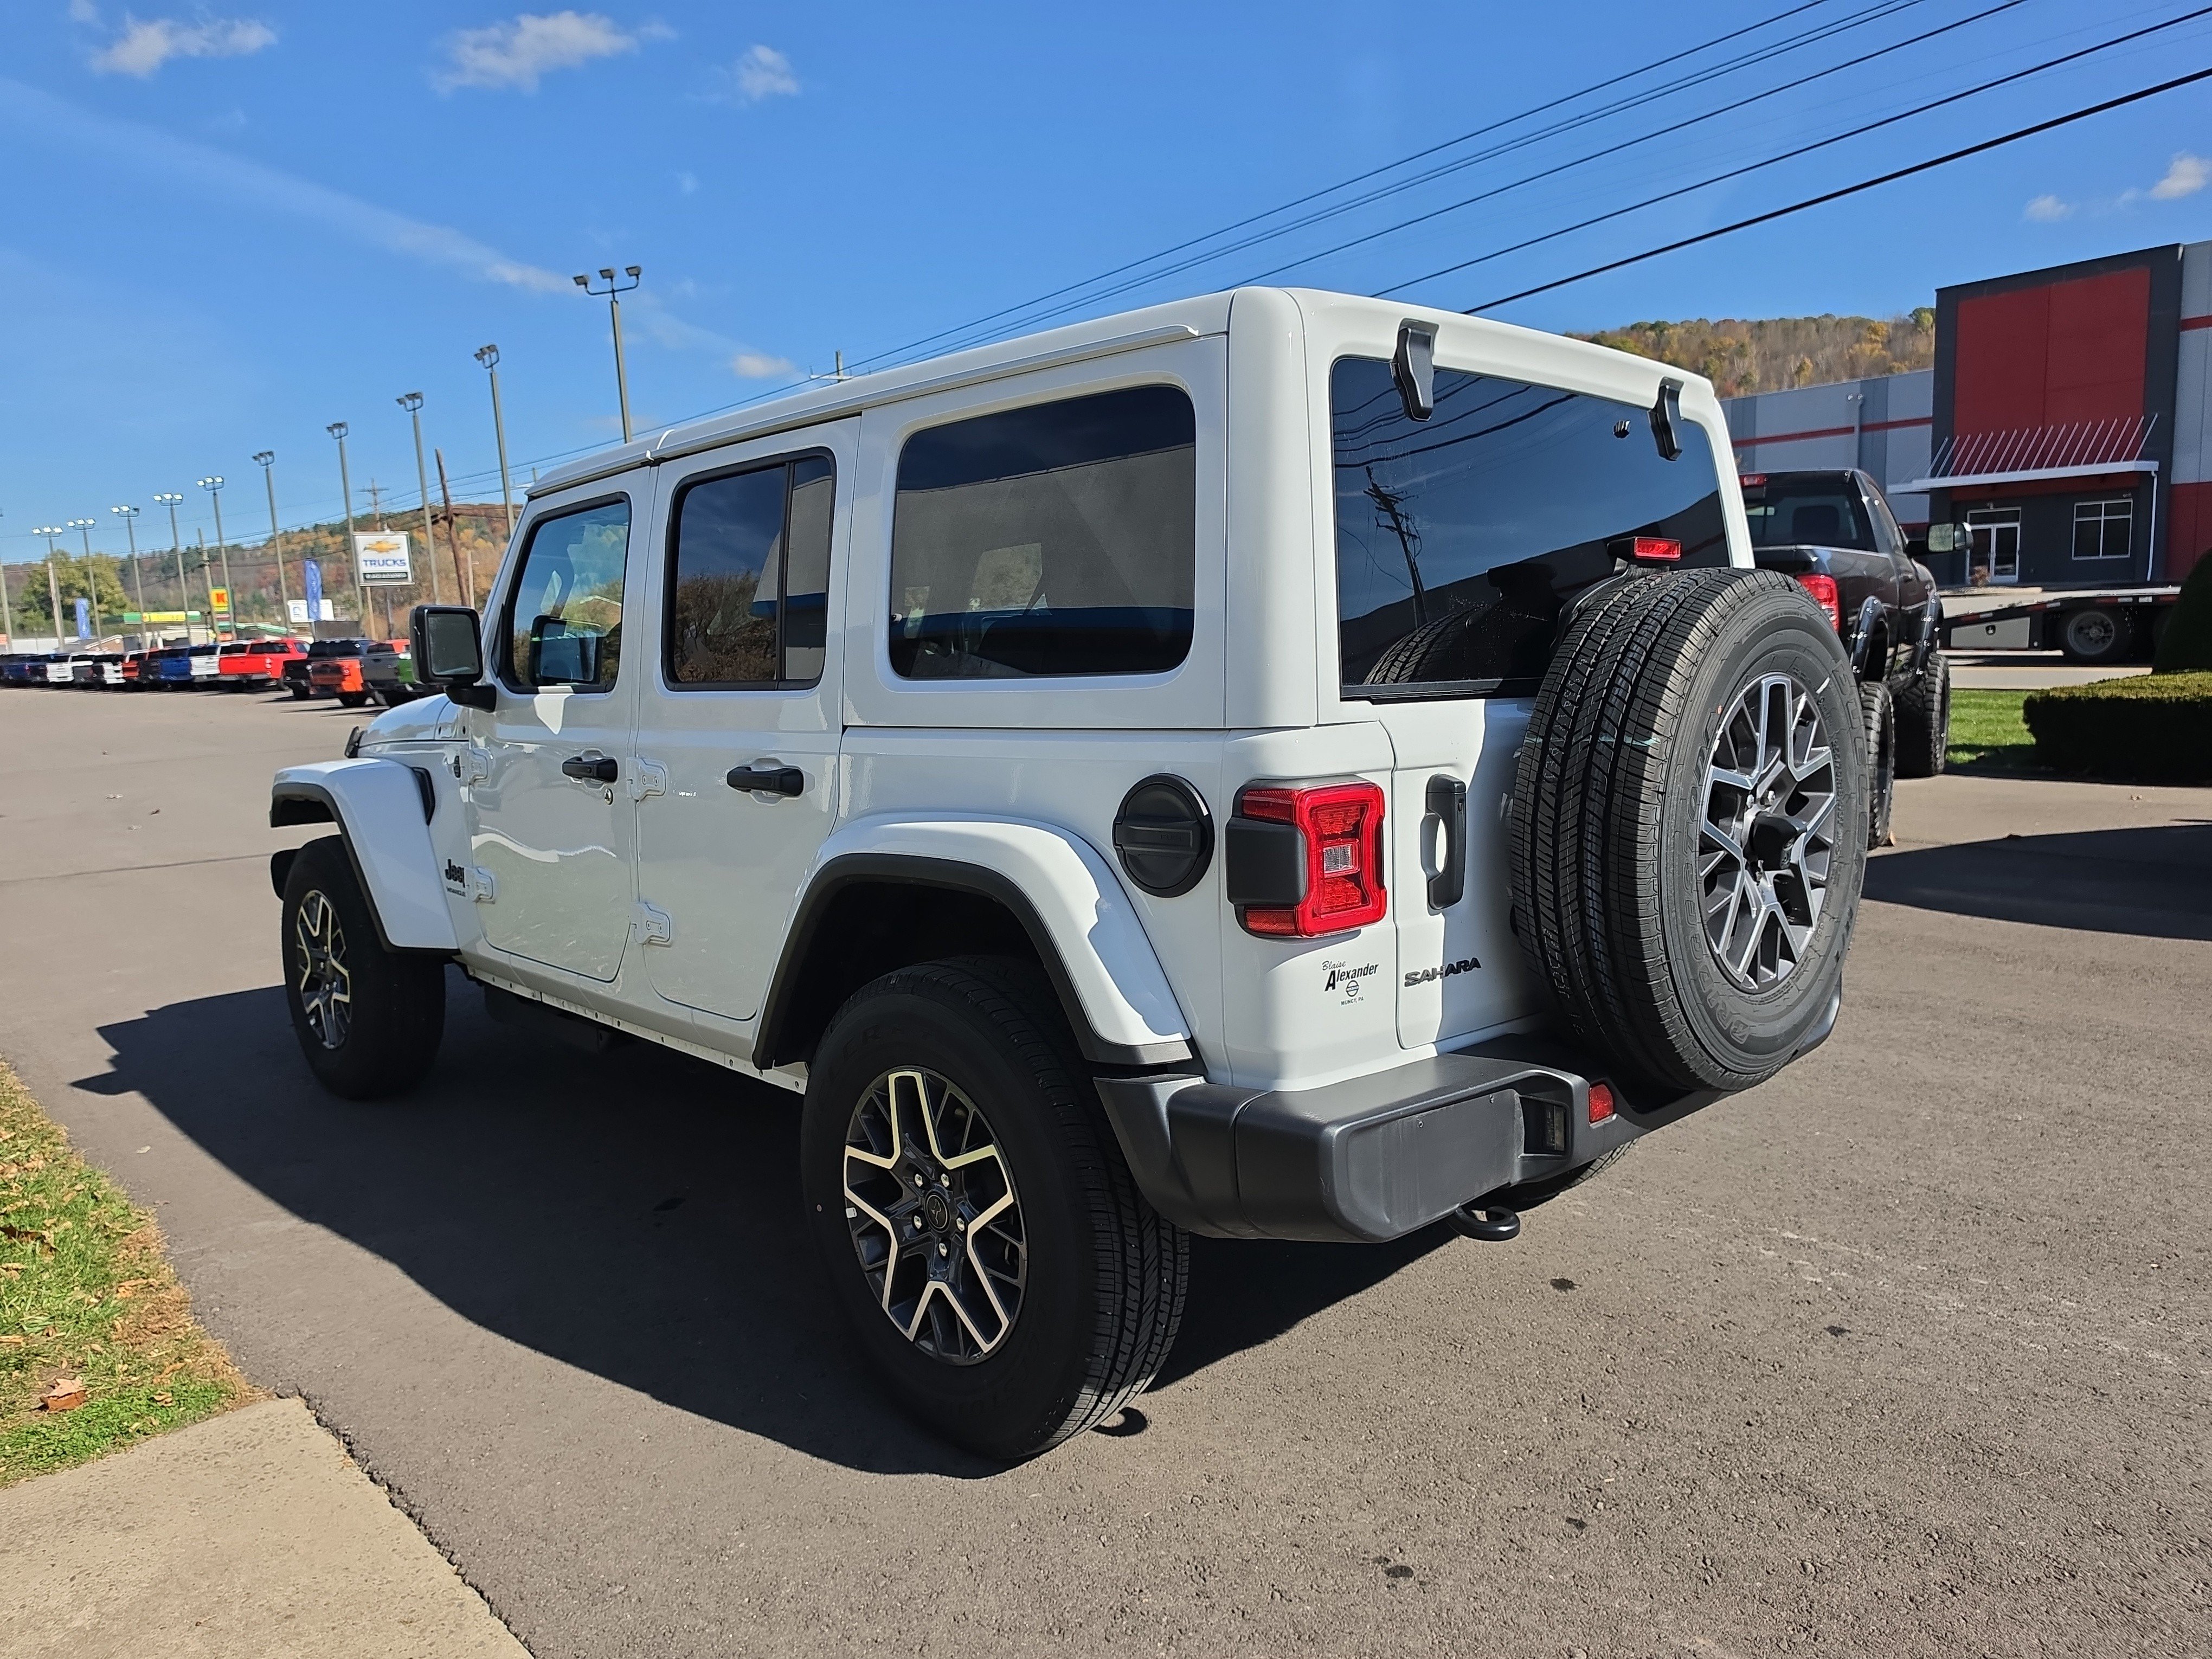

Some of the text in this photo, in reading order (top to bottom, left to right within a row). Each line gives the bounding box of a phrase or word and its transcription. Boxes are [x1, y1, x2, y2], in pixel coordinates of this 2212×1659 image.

[445, 859, 466, 888] Jeep
[1322, 960, 1346, 970] Blaise
[1324, 963, 1379, 992] Alexander
[1404, 957, 1482, 987] SAHARA
